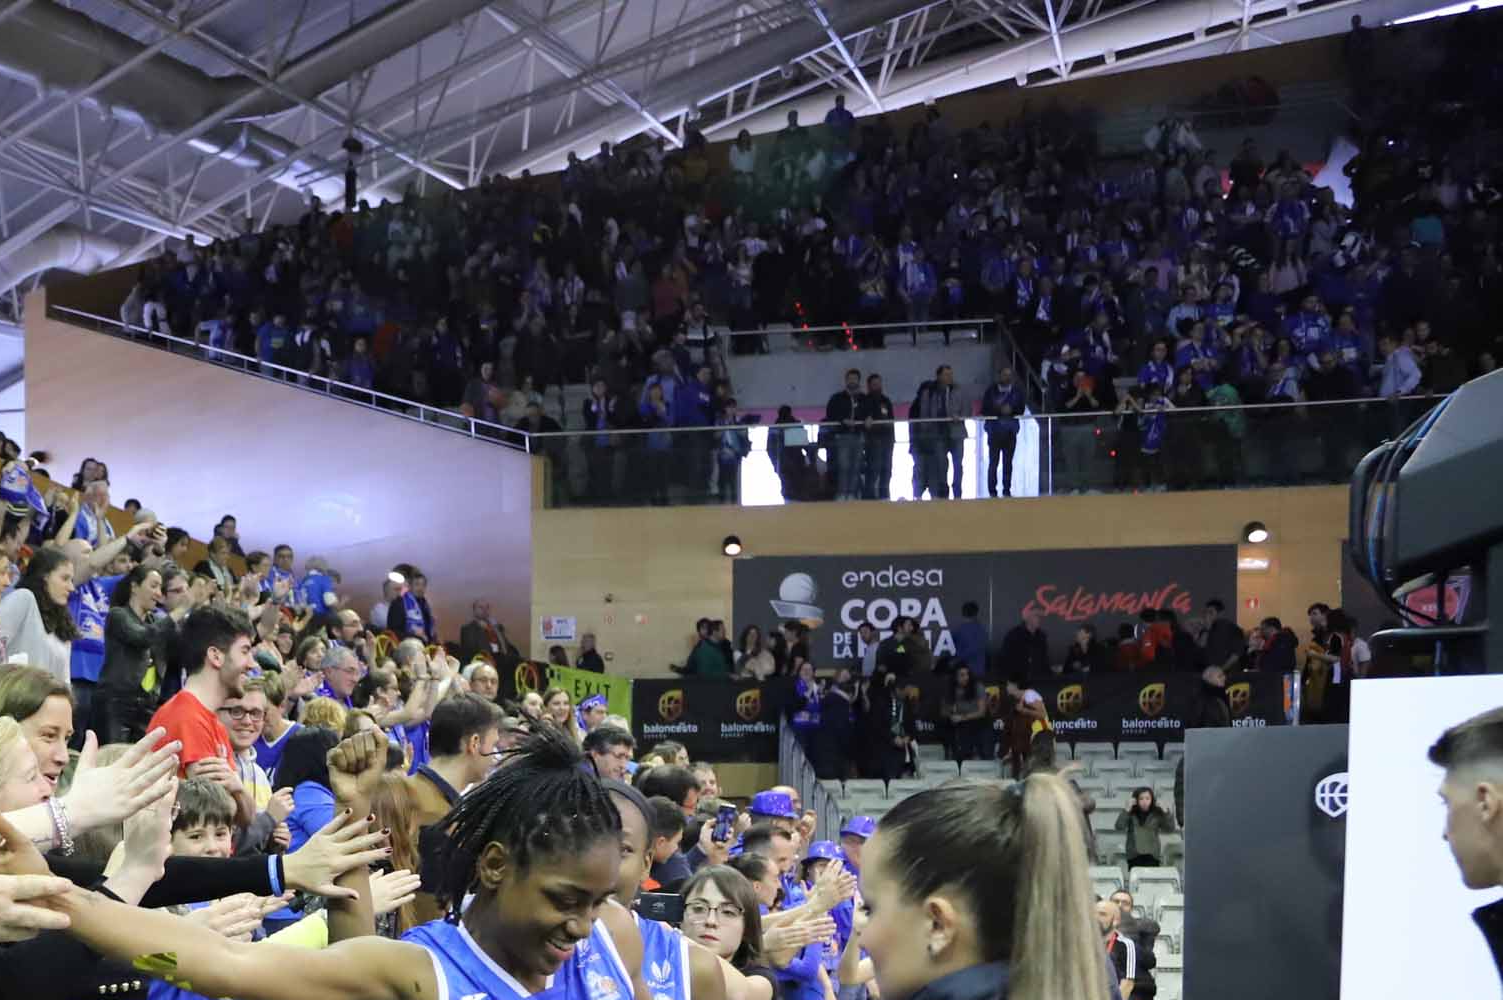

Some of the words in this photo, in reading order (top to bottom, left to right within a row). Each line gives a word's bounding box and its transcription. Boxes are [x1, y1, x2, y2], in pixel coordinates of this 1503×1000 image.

[842, 565, 943, 588] endesa
[840, 597, 948, 630] COPA
[833, 632, 852, 644] DE
[833, 646, 853, 658] LA
